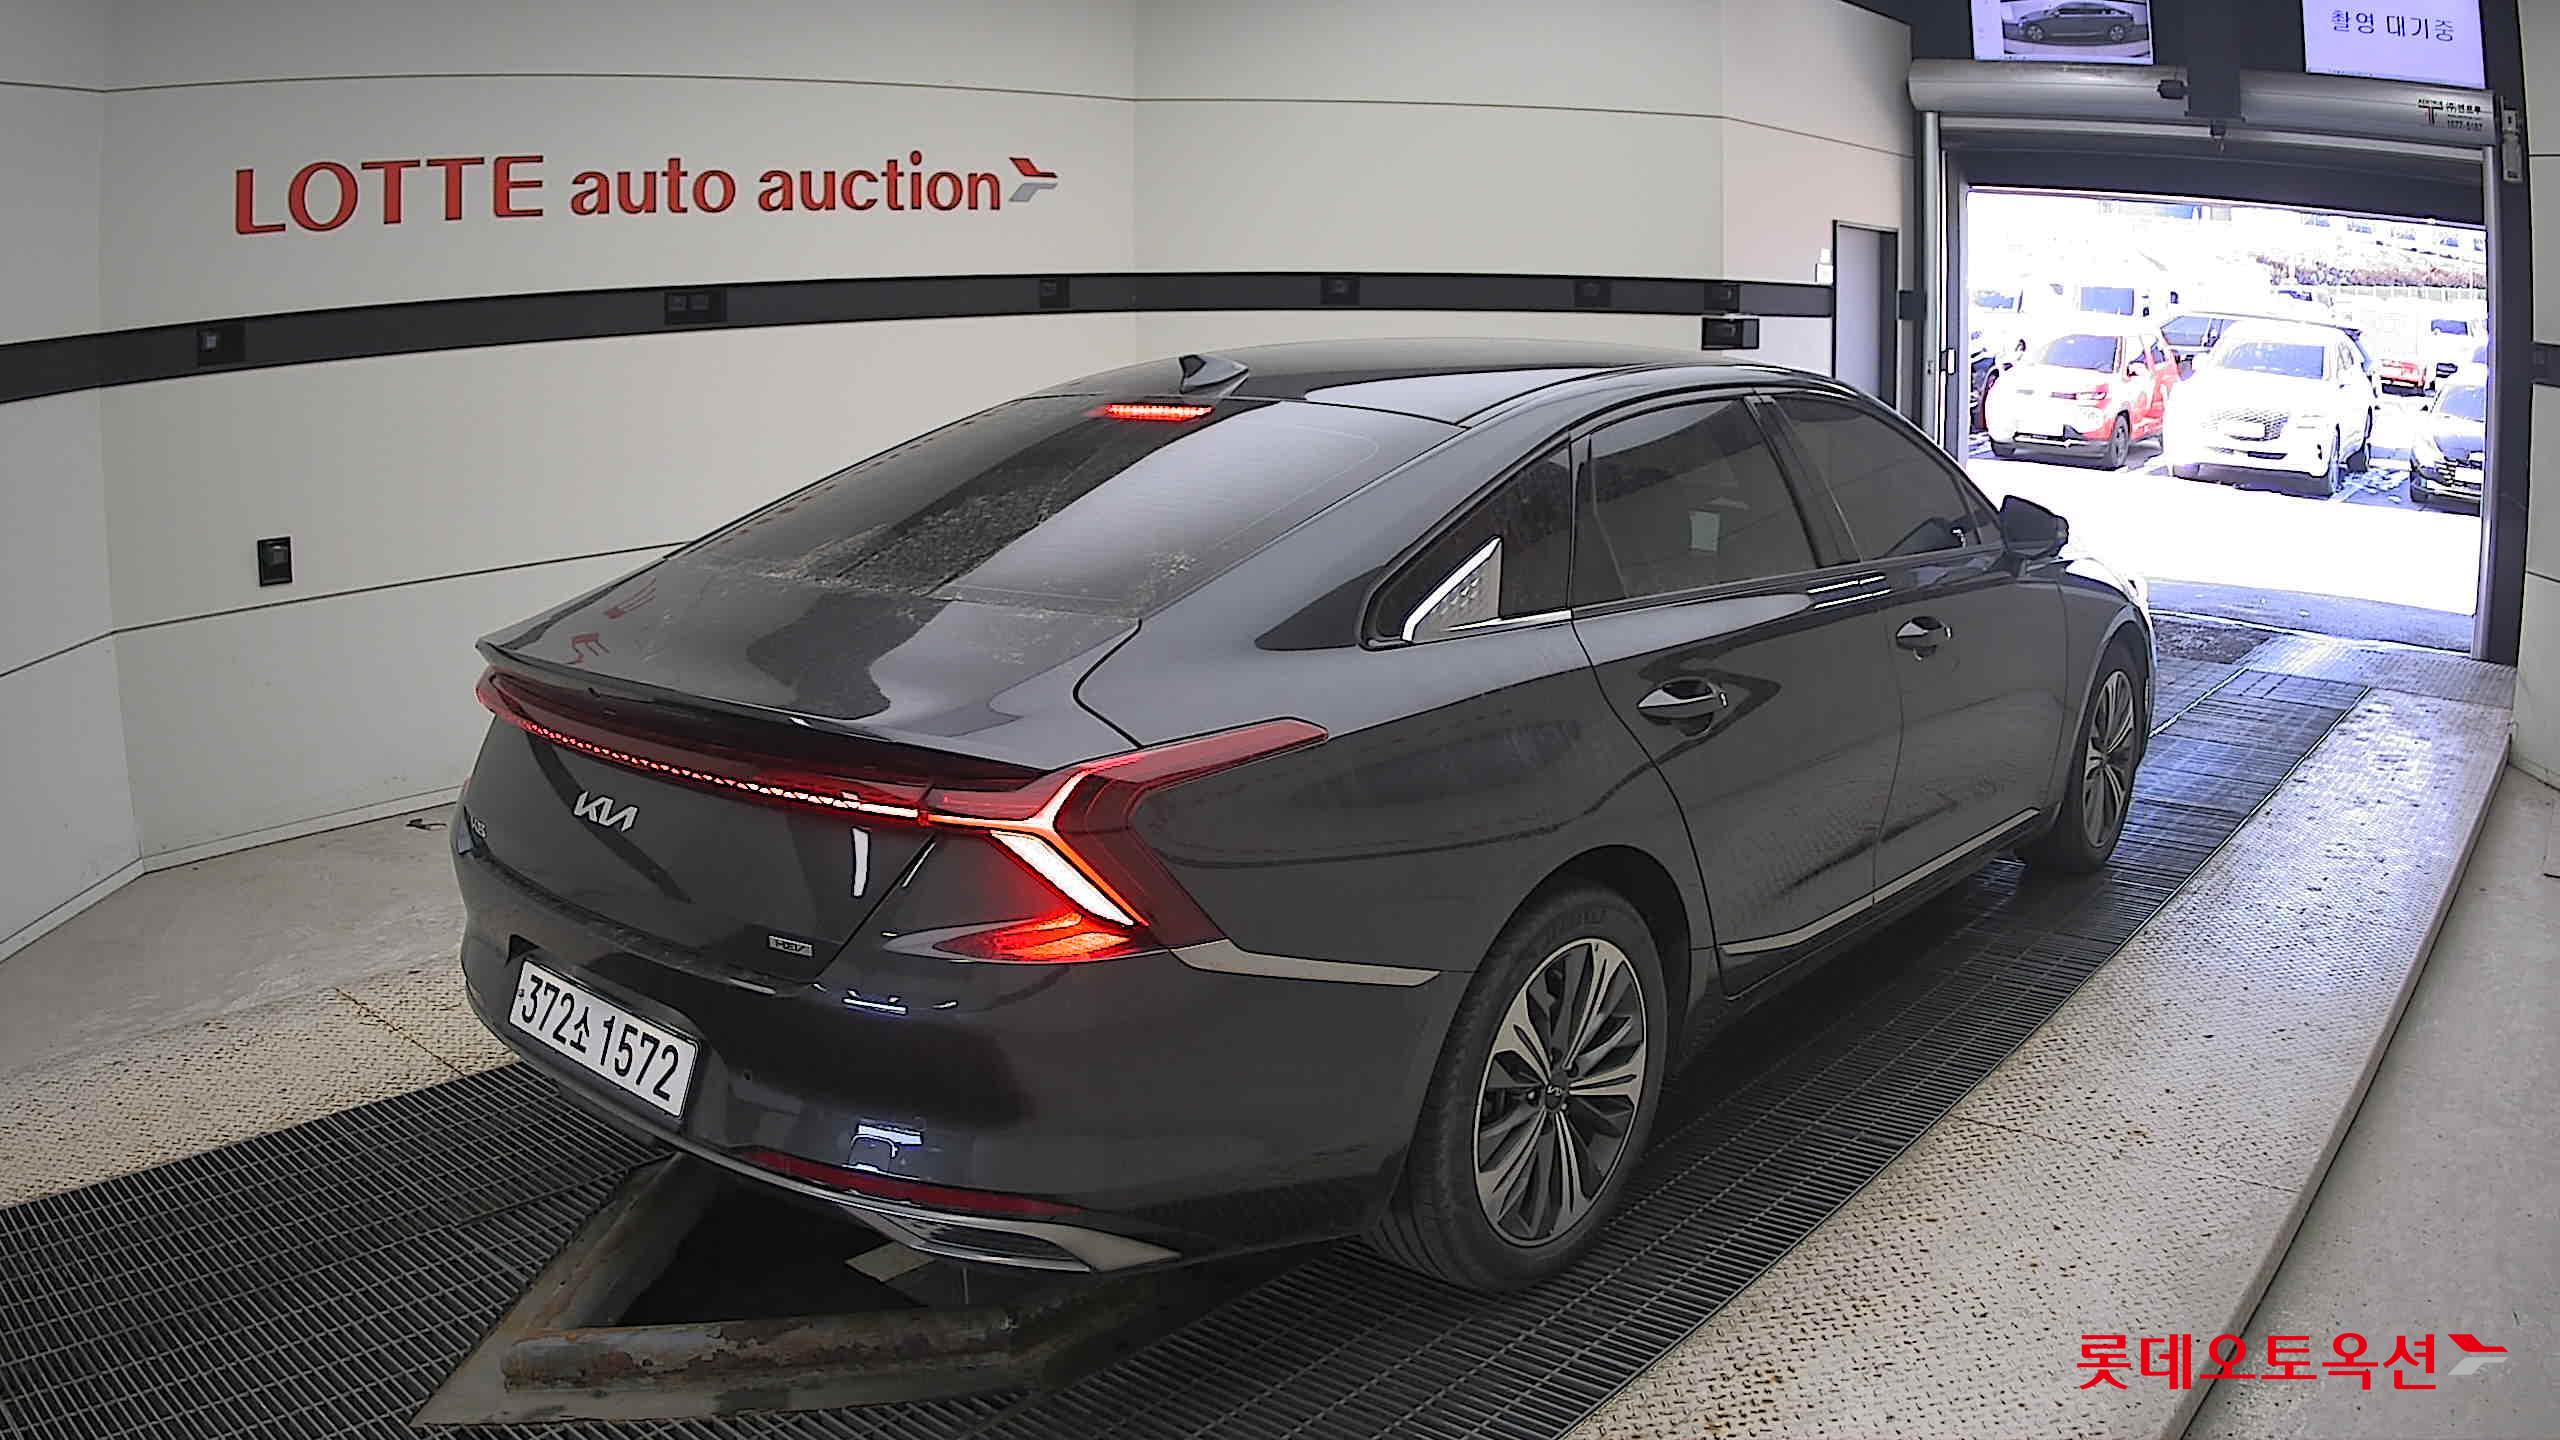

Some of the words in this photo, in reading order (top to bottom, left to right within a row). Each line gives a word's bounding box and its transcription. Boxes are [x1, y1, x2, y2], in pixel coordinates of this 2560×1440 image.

[2331, 9, 2375, 34] 촬영
[2386, 15, 2454, 42] 대기중
[234, 154, 545, 235] LOTTE
[569, 156, 737, 216] auto
[756, 149, 1003, 213] auction
